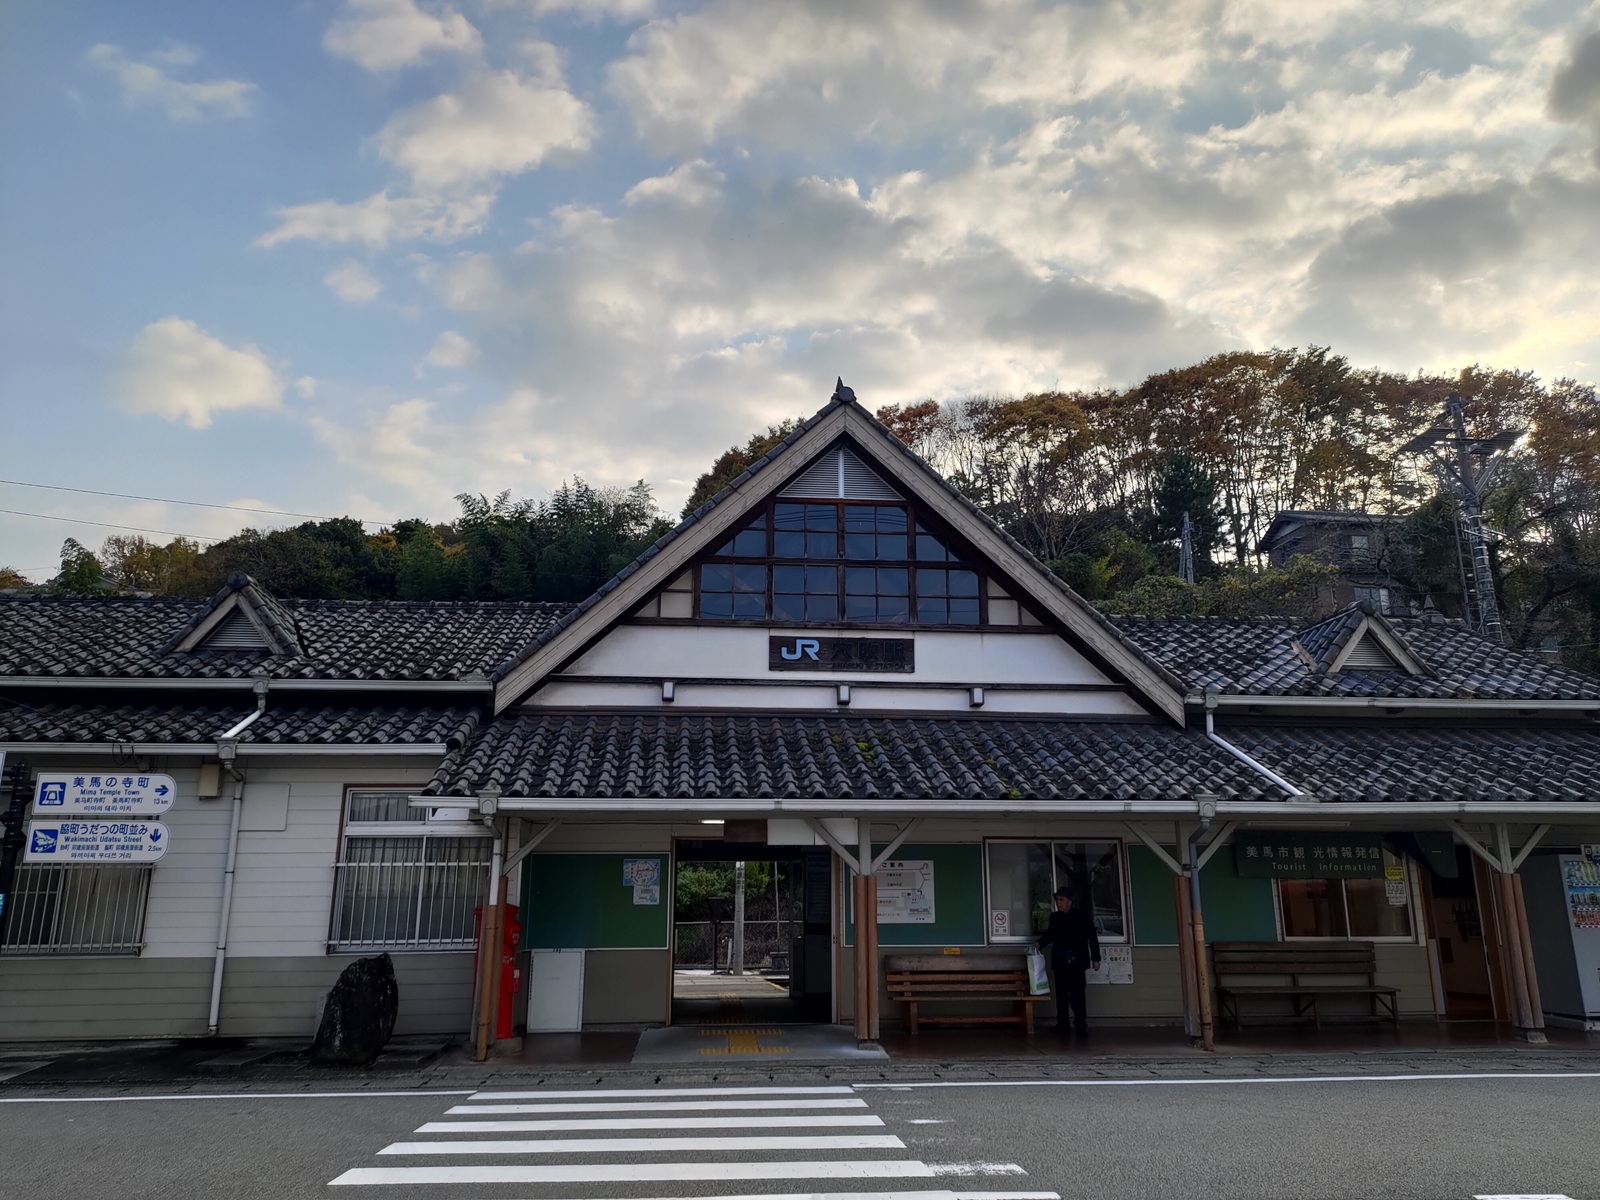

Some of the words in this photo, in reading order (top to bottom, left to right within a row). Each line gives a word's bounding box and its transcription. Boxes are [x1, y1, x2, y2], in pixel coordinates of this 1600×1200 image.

[780, 638, 820, 661] JR
[73, 776, 150, 788] 美馬の寺町
[99, 789, 121, 797] Temple
[60, 823, 148, 835] 脇町うだつの町並み
[1246, 845, 1380, 860] 美馬市観光情報発信
[1271, 861, 1307, 871] Tourist
[1319, 862, 1377, 872] Information
